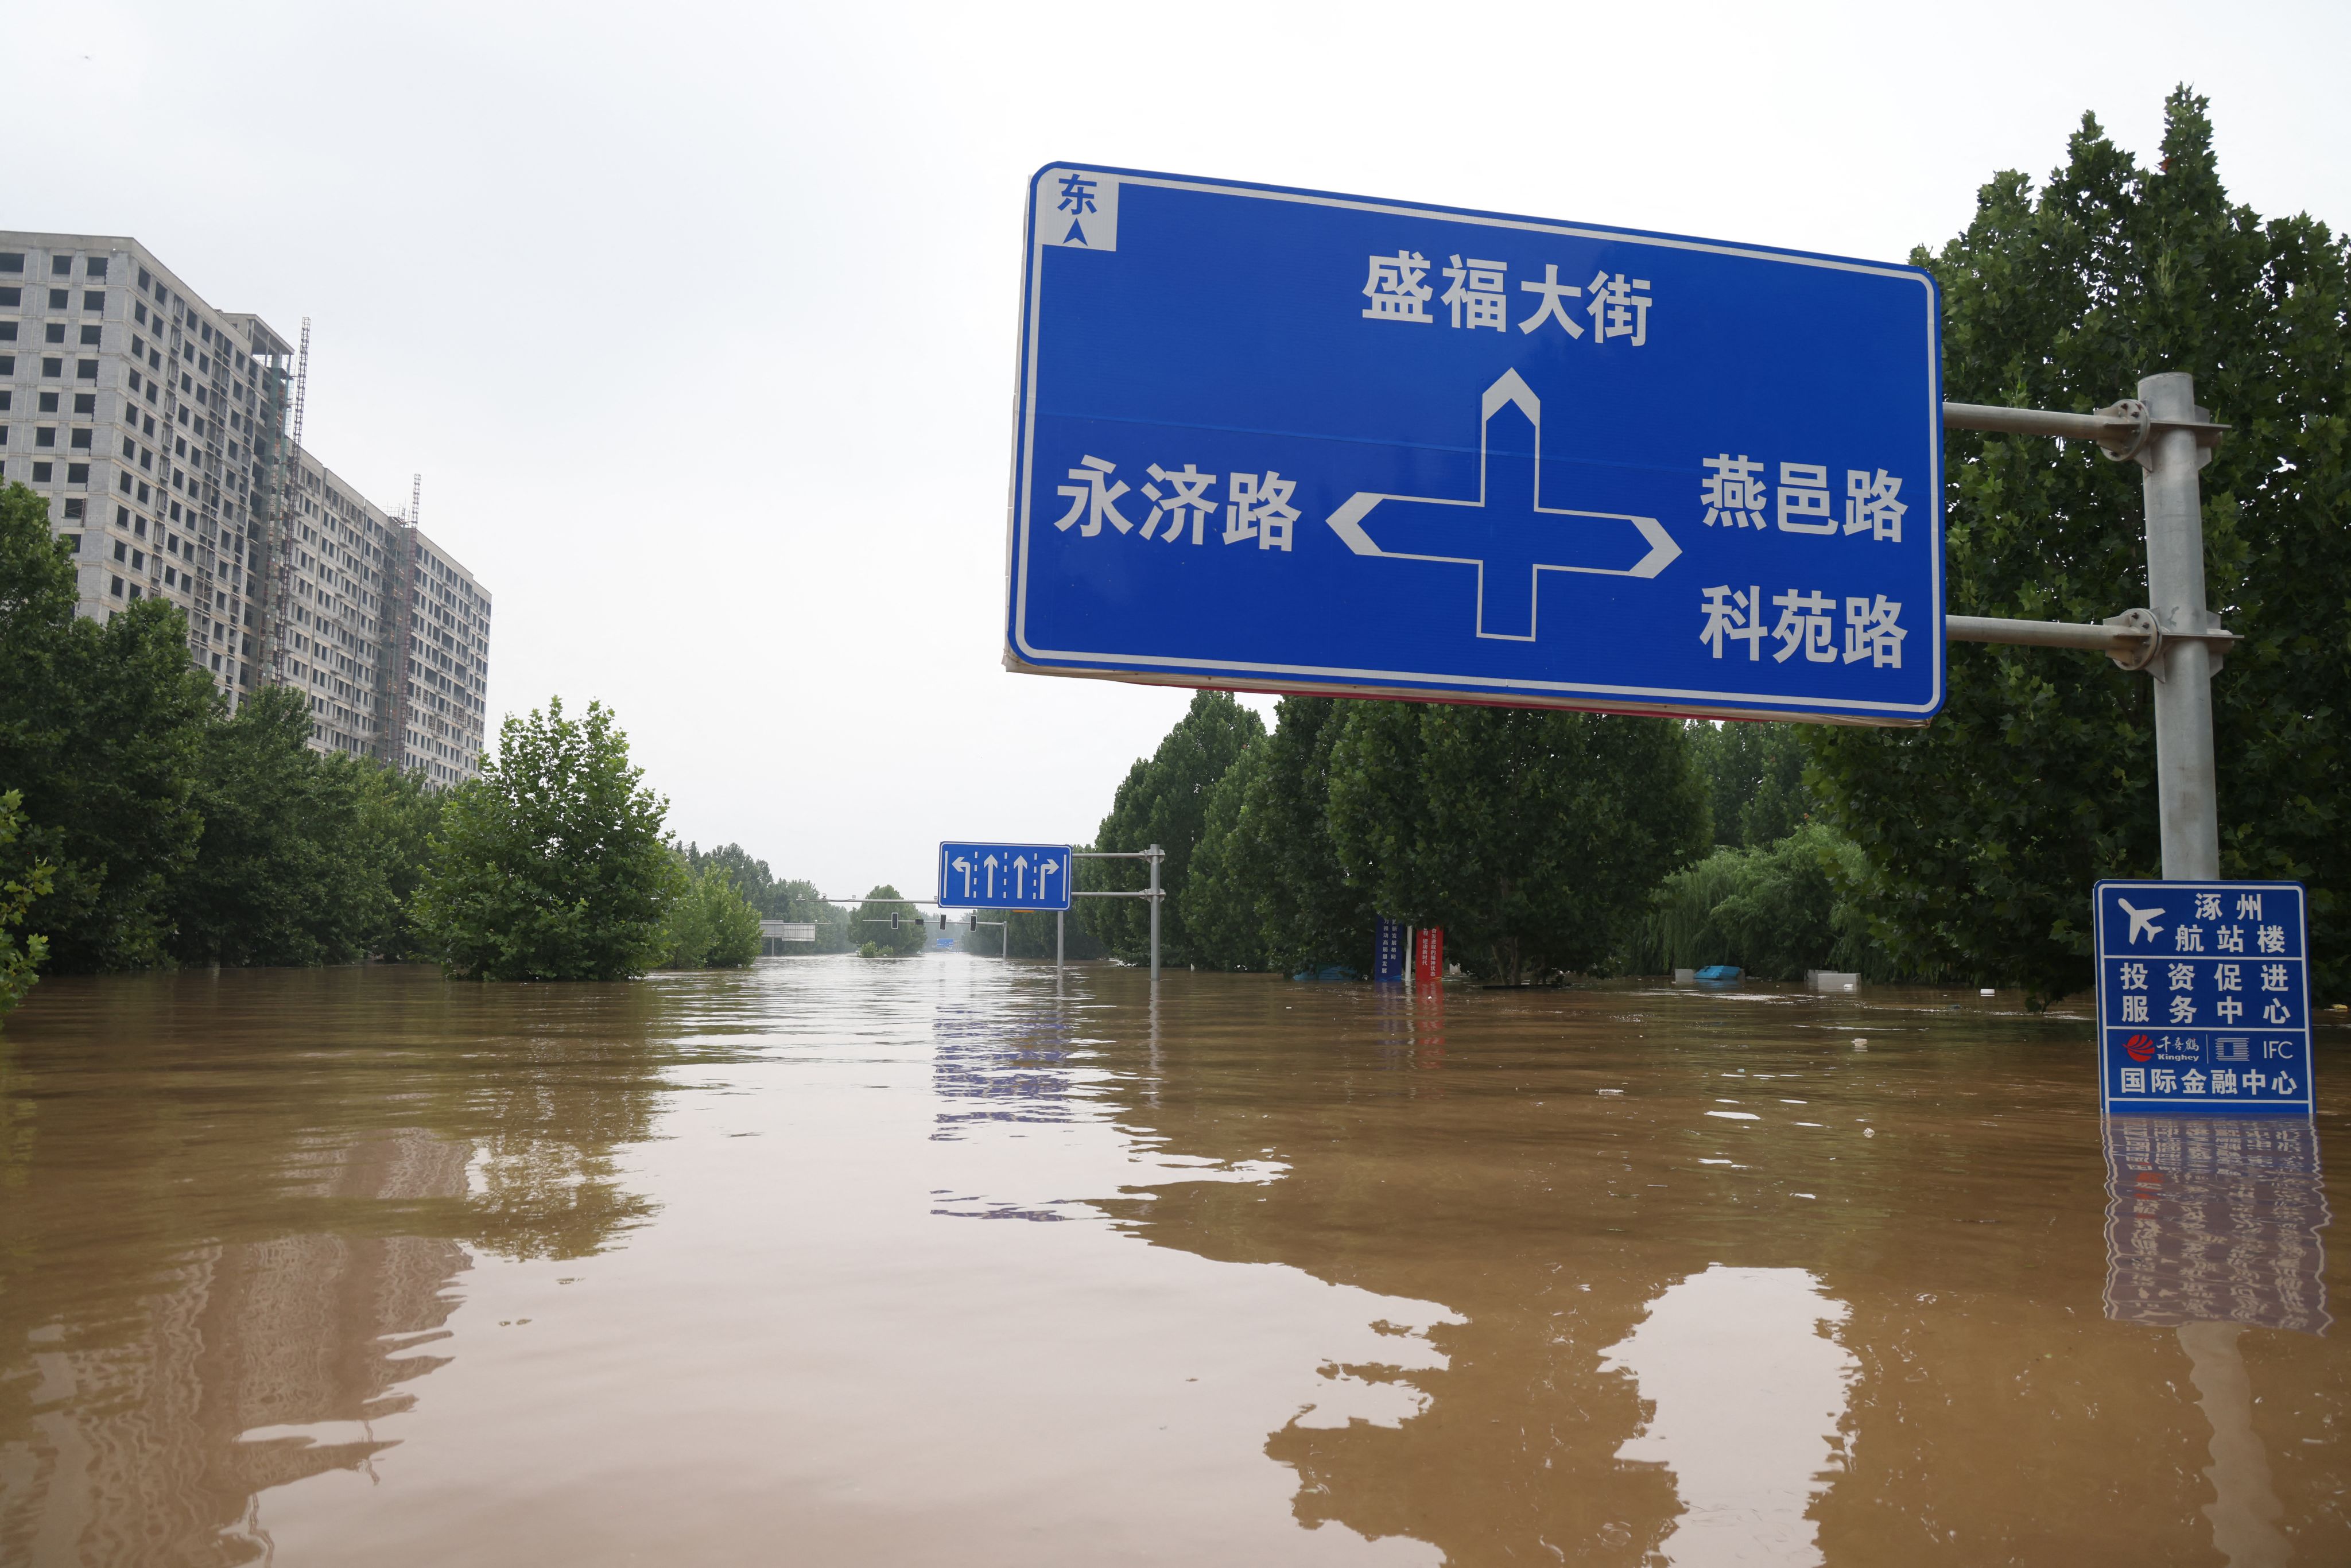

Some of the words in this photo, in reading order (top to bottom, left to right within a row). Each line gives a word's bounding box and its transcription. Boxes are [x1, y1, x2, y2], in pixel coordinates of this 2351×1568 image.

[1057, 174, 1097, 215] 东
[1362, 250, 1652, 347] 盛福大街
[1054, 455, 1301, 551] 永济路
[1701, 453, 1908, 542] 燕邑路
[1700, 585, 1907, 668] 科苑路
[2195, 893, 2261, 921] 涿州
[2175, 925, 2285, 953] 航站楼
[2120, 962, 2288, 991] 投资促进
[2122, 995, 2290, 1024] 服务中心
[2157, 1054, 2199, 1062] Kinghey
[2264, 1041, 2292, 1058] IFC
[2121, 1068, 2297, 1095] 国际金融中心
